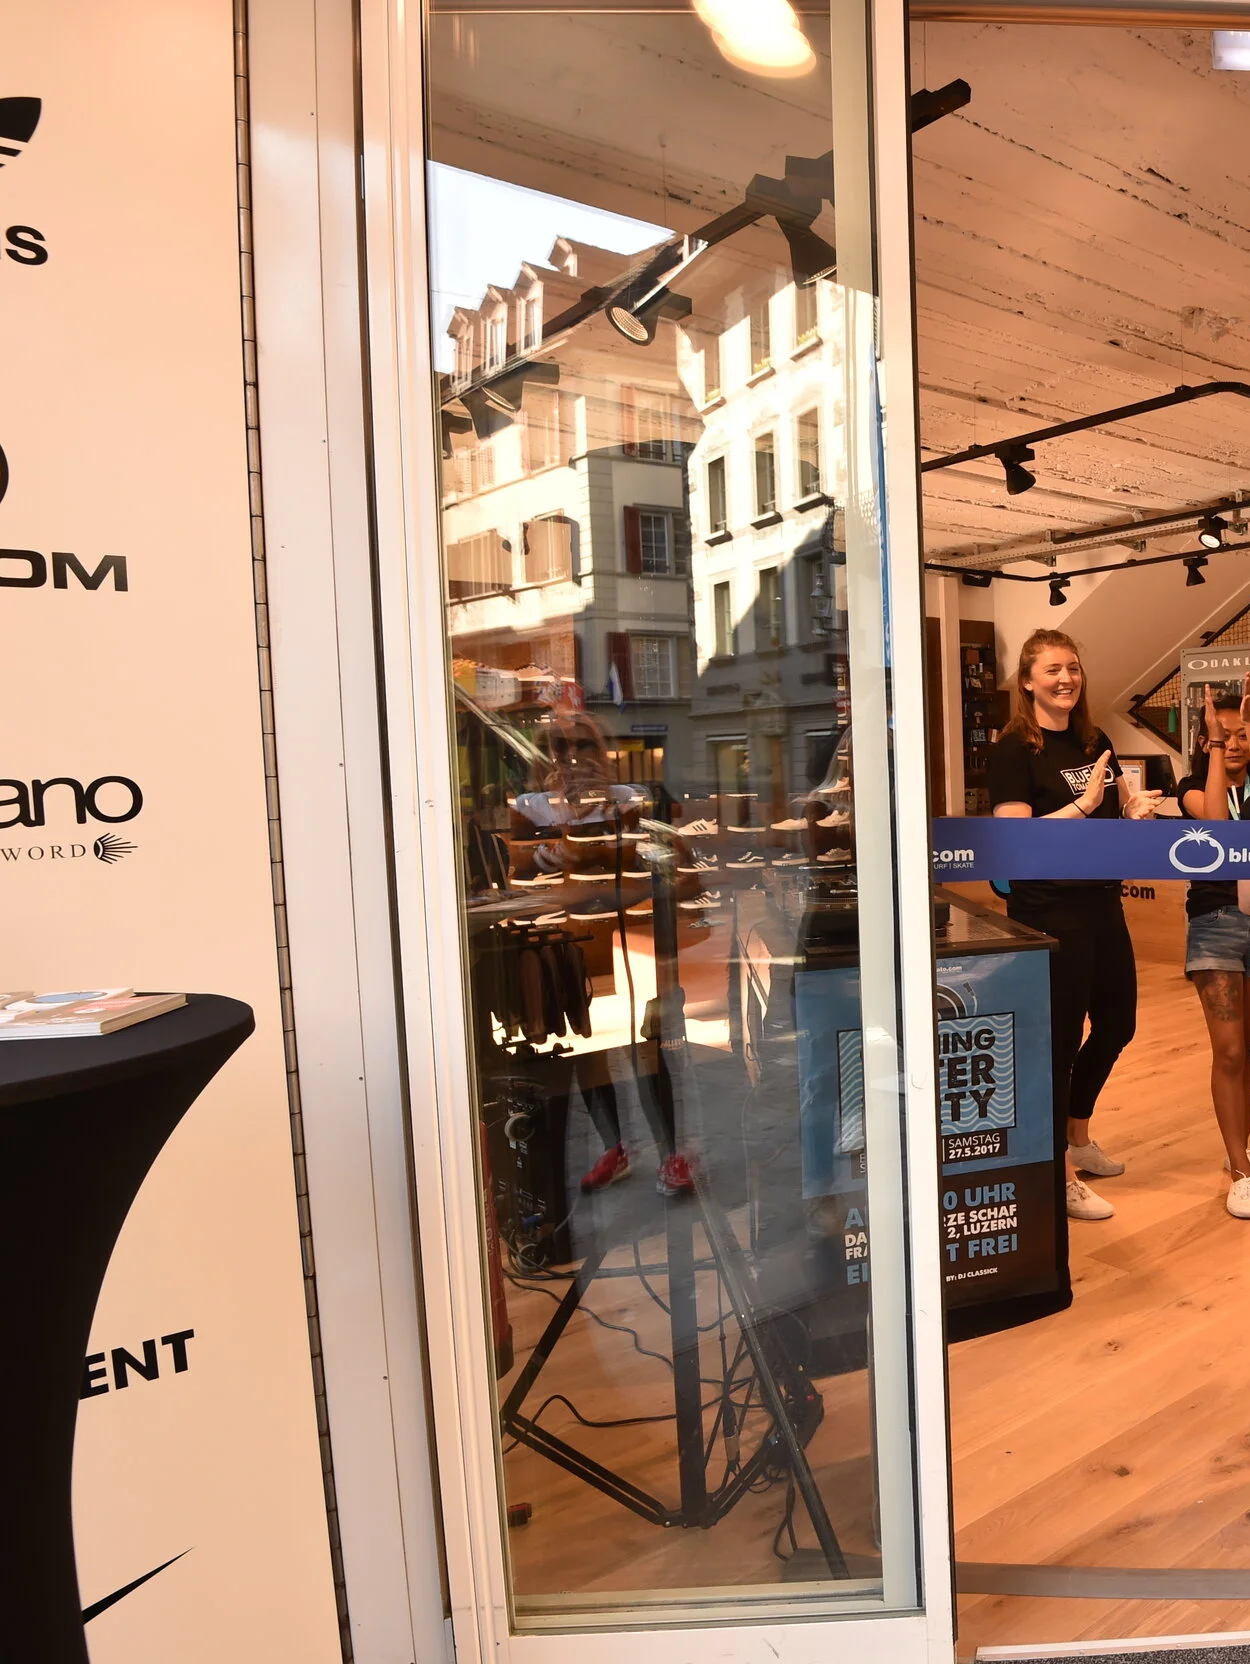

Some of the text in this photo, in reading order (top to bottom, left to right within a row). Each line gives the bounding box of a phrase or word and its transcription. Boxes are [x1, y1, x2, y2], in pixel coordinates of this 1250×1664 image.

[1064, 769, 1091, 784] BLUE
[939, 1028, 996, 1054] ING
[941, 1087, 997, 1123] TY
[948, 1133, 1000, 1149] SAMSTAG
[948, 1143, 1001, 1160] 27.5.2017
[964, 1182, 1017, 1207] UHR
[944, 1210, 966, 1228] ZE
[969, 1204, 1018, 1222] SCHAF
[963, 1216, 1018, 1237] LUZERN
[968, 1233, 1019, 1260] FREI
[957, 1272, 967, 1280] DJ
